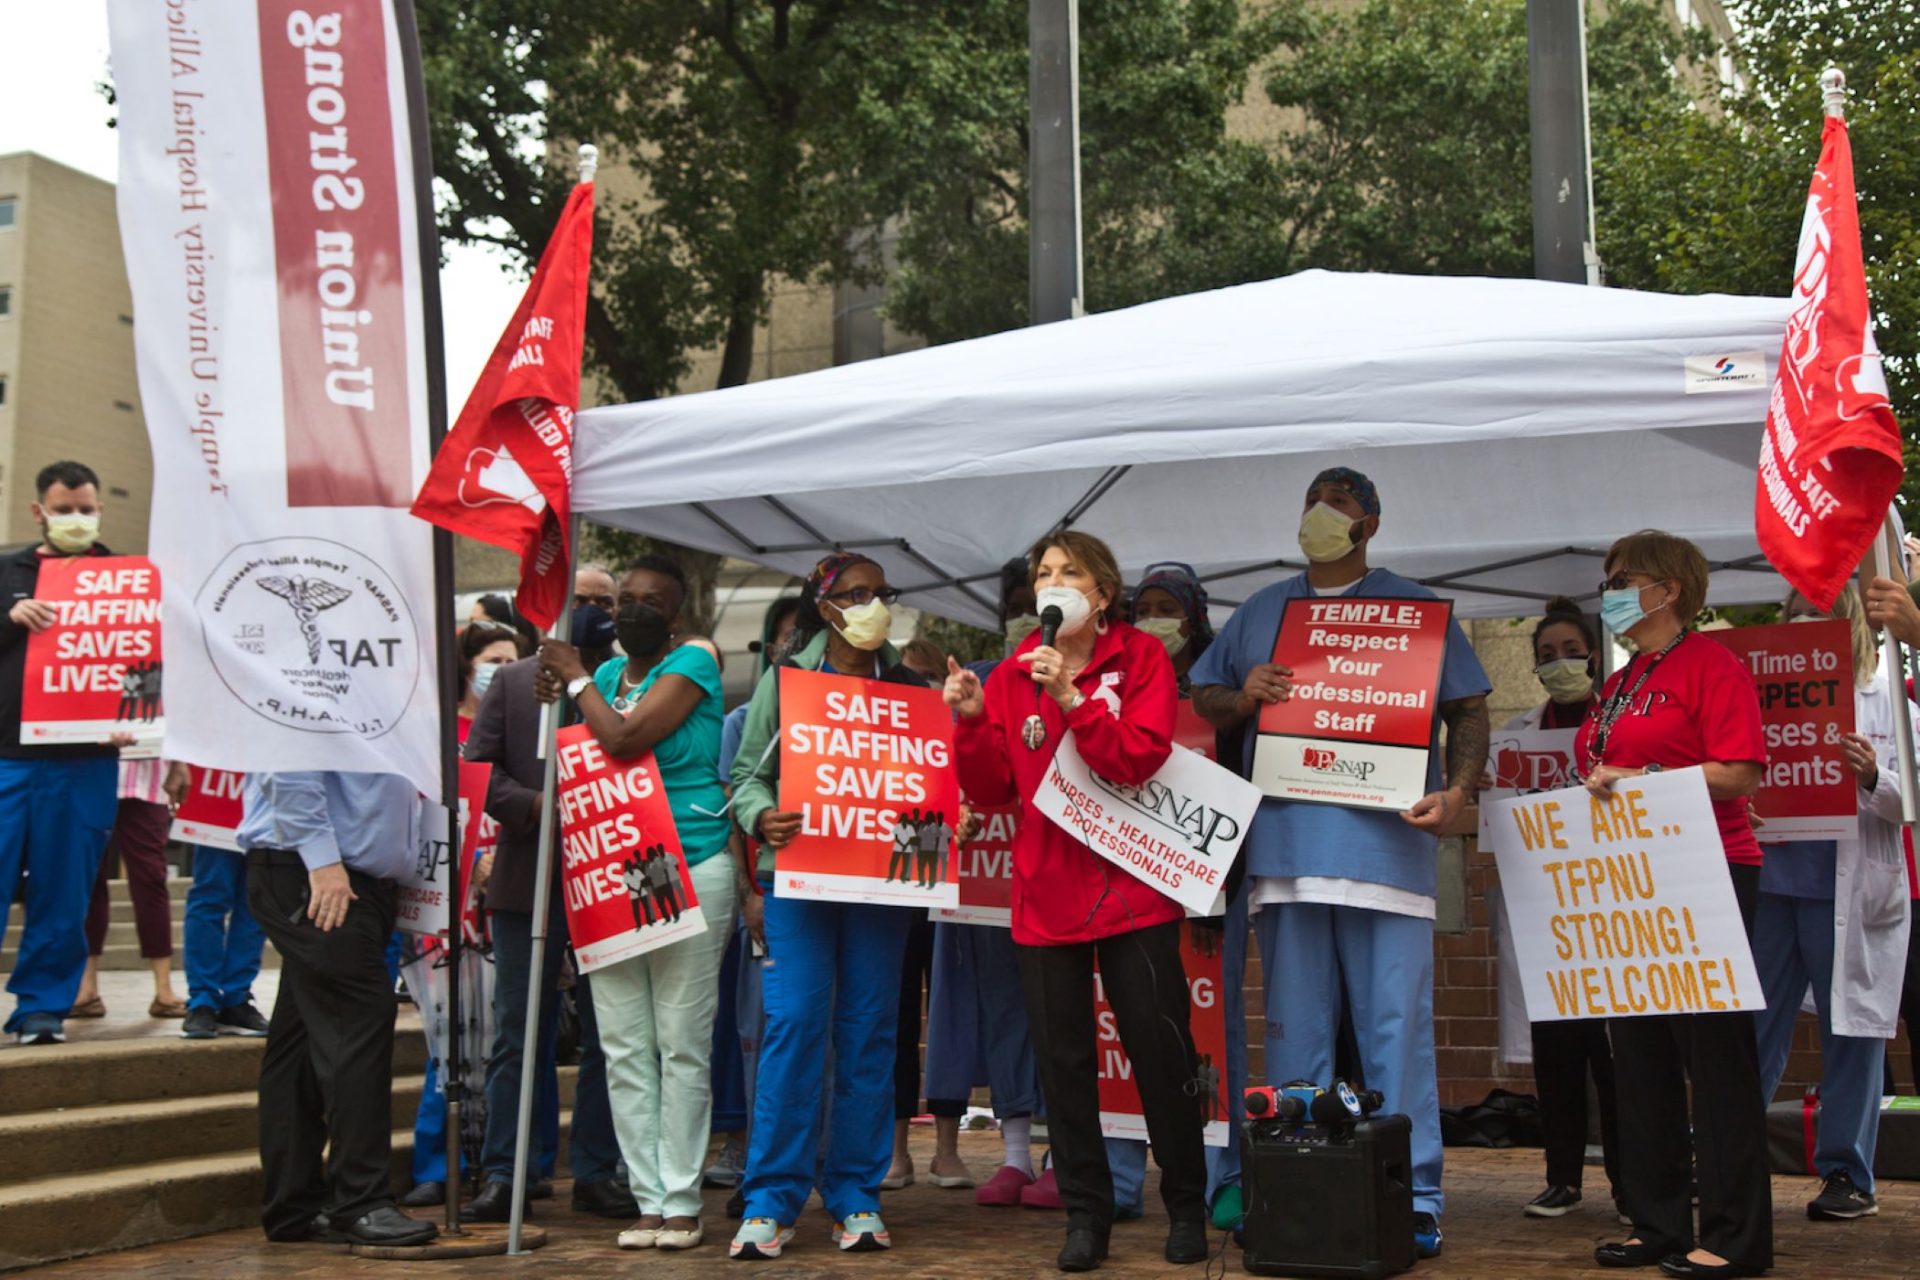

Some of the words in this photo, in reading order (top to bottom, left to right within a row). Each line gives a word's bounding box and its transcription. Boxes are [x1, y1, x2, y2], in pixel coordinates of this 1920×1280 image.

[74, 569, 152, 596] SAFE
[1310, 604, 1423, 626] TEMPLE:
[56, 630, 152, 660] SAVES
[1308, 629, 1409, 652] Respect
[42, 663, 127, 693] LIVES
[1327, 655, 1383, 677] Your
[1748, 650, 1807, 675] Time
[1811, 648, 1838, 672] to
[825, 691, 910, 729] SAFE
[1289, 681, 1426, 709] rofessional
[1314, 710, 1376, 732] Staff
[1823, 722, 1843, 745] &
[556, 739, 606, 786] AFE
[789, 723, 949, 768] STAFFING
[201, 769, 246, 800] LIV
[815, 764, 926, 803] SAVES
[801, 802, 898, 842] LIVES
[1050, 771, 1104, 819] NURSES
[1106, 816, 1115, 826] +
[1118, 820, 1219, 885] HEALTHCARE
[1512, 801, 1568, 851] WE
[563, 813, 641, 870] SAVES
[1062, 804, 1183, 889] PROFESSIONALS
[566, 862, 629, 912] LIVES
[1543, 851, 1655, 908] TFPNU
[1551, 906, 1701, 960] STRONG!
[1546, 958, 1741, 1017] WELCOME!
